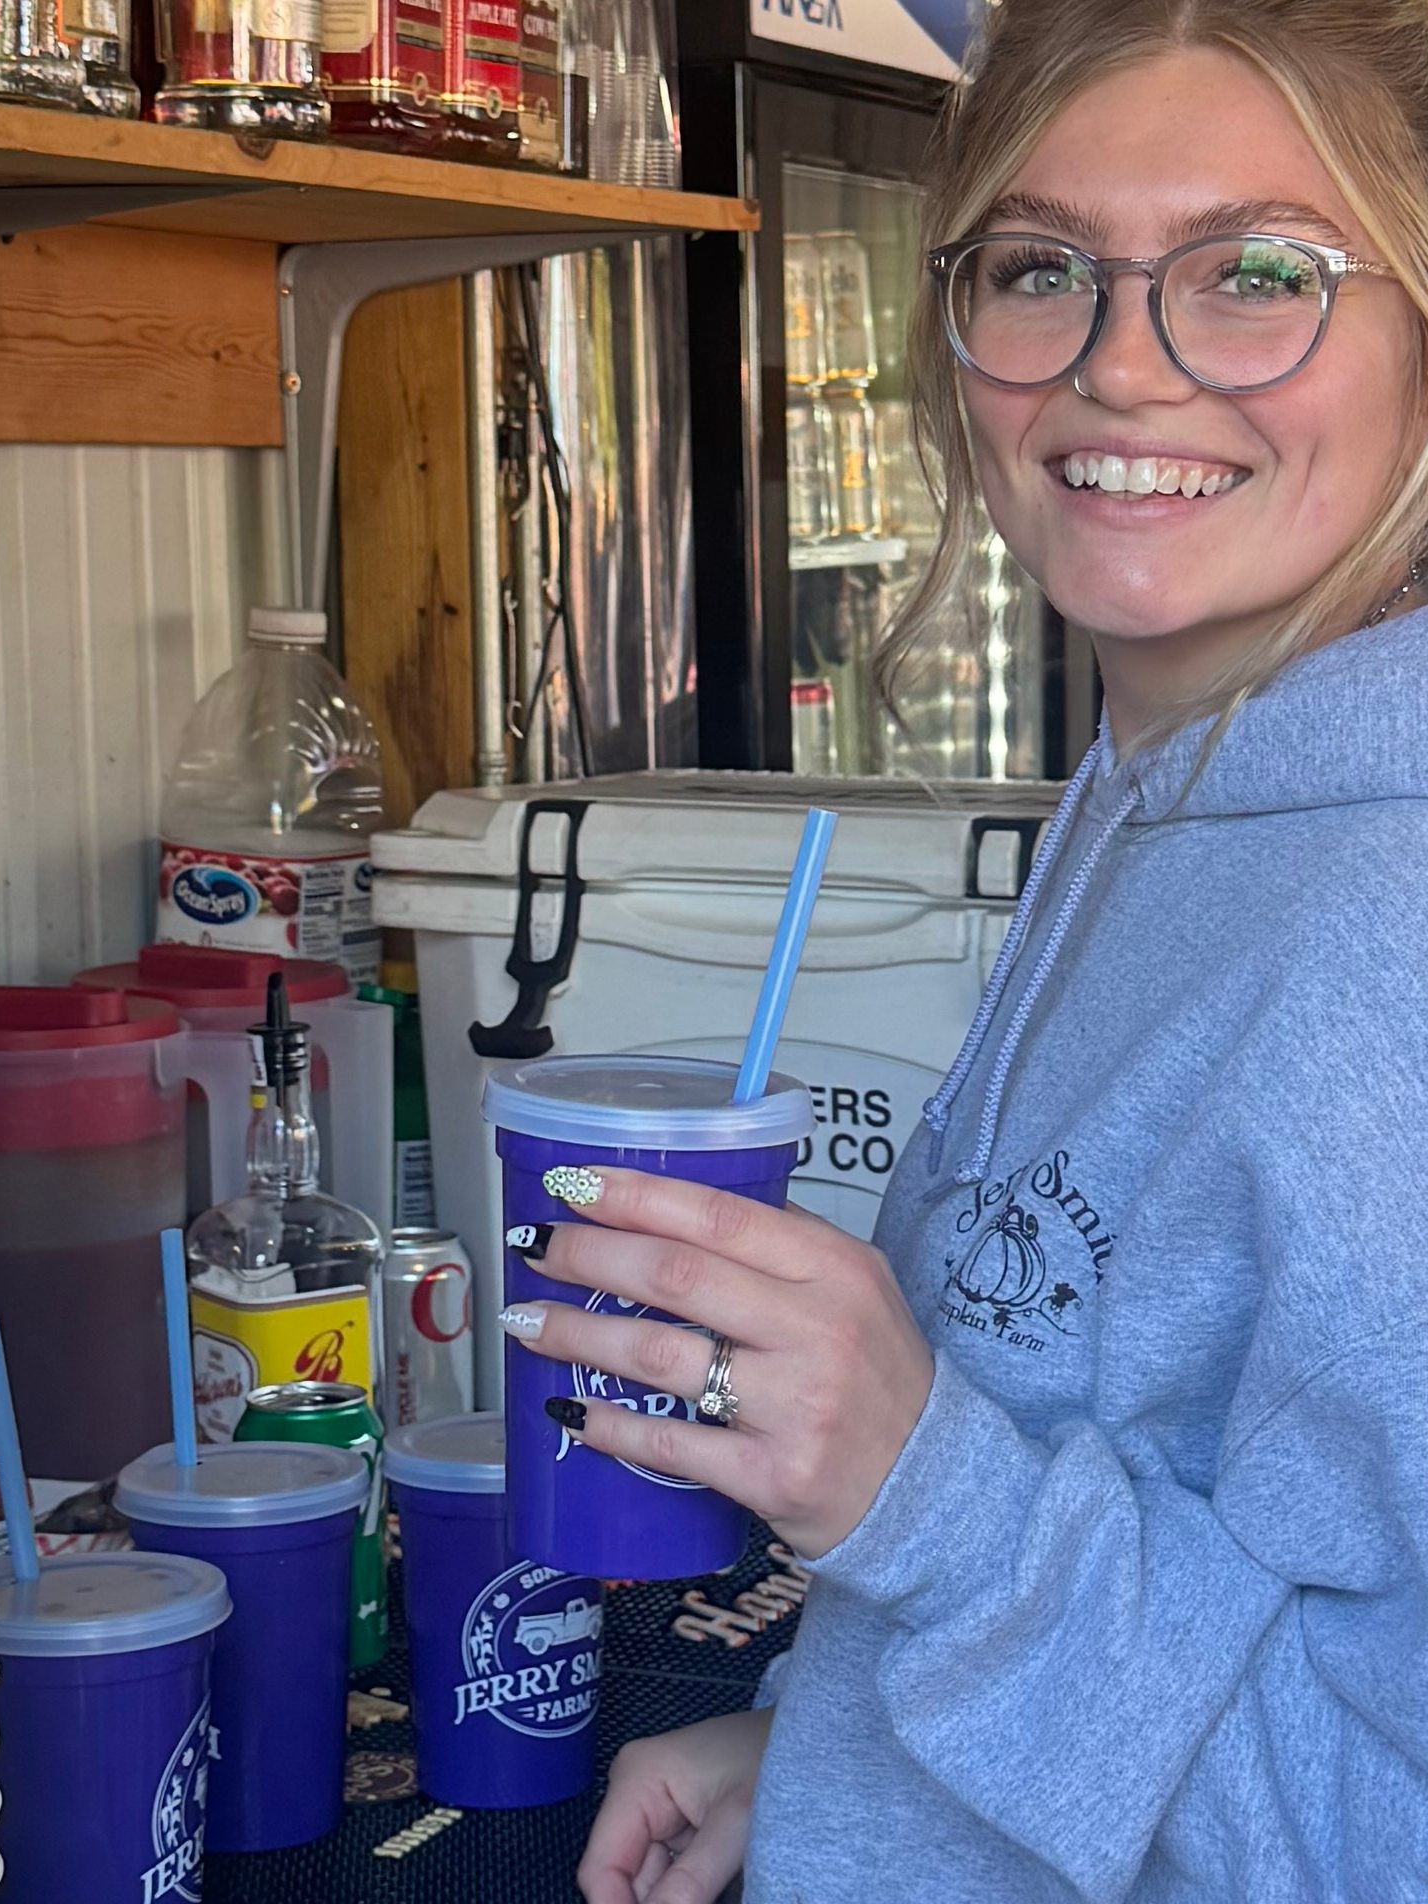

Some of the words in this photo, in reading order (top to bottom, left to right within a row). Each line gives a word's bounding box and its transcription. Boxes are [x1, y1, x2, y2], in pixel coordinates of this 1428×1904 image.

[995, 1309, 1046, 1354] Farm
[454, 1658, 568, 1726] JERRY
[536, 1692, 592, 1723] FARM
